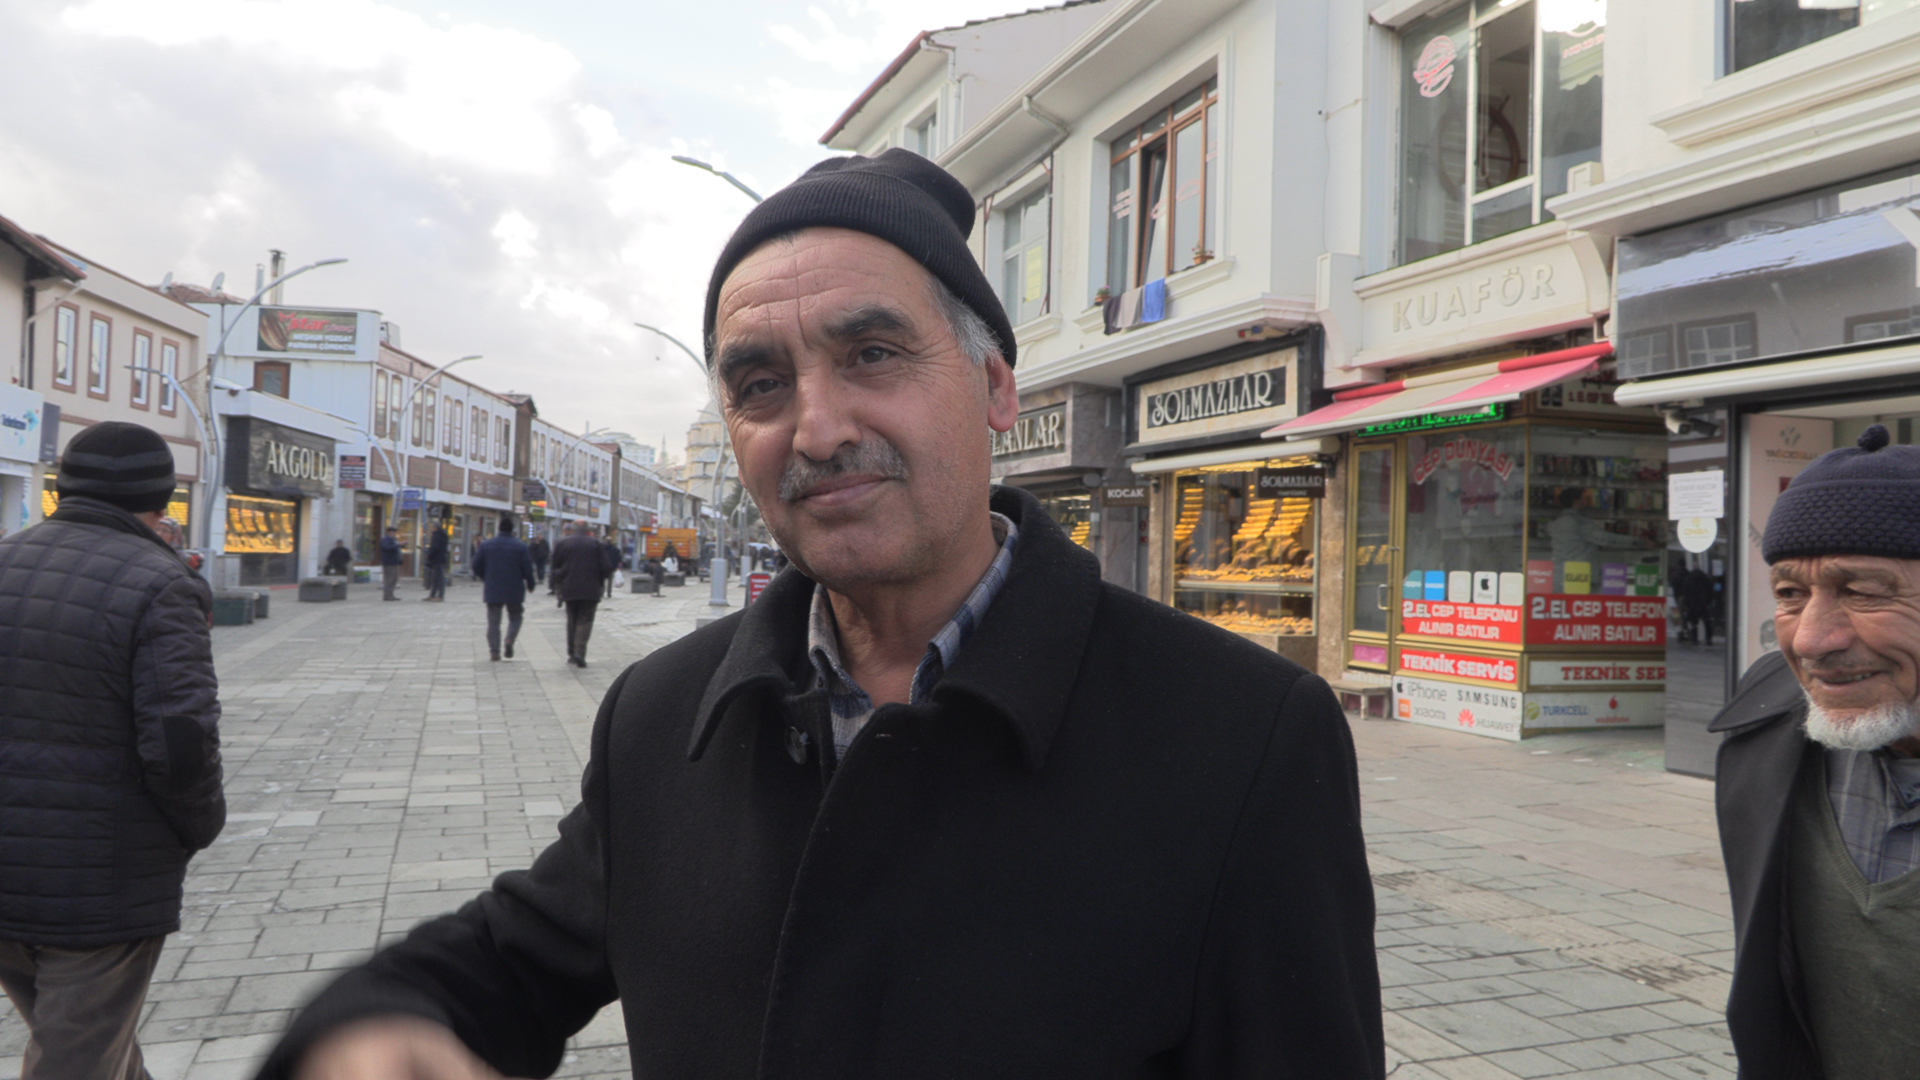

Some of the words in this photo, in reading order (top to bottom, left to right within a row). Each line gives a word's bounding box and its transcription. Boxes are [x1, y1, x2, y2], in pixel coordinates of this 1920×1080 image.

[1393, 263, 1555, 333] KUAFÖR
[1151, 372, 1273, 426] SOLMAZLAR
[266, 440, 329, 481] AKGOLD
[1415, 447, 1442, 486] CEP
[1445, 434, 1515, 481] DÜNYASI
[1261, 475, 1322, 488] SOLMAZLAR
[1403, 600, 1431, 618] 2.EL
[1432, 604, 1455, 617] CEP
[1456, 606, 1518, 623] TELEFONU
[1531, 596, 1571, 619] 2.EL
[1573, 601, 1602, 617] CEP
[1419, 621, 1454, 635] ALINIR
[1456, 623, 1500, 639] SATILIR
[1554, 624, 1601, 640] ALINIR
[1604, 625, 1656, 641] SATILIR
[1402, 653, 1456, 674] TEKNİK
[1457, 660, 1516, 681] SERVİS
[1561, 662, 1631, 680] TEKNİK
[1408, 681, 1447, 702] iPhone
[1457, 689, 1518, 710] SAMSUNG
[1542, 705, 1589, 716] TURKCELL
